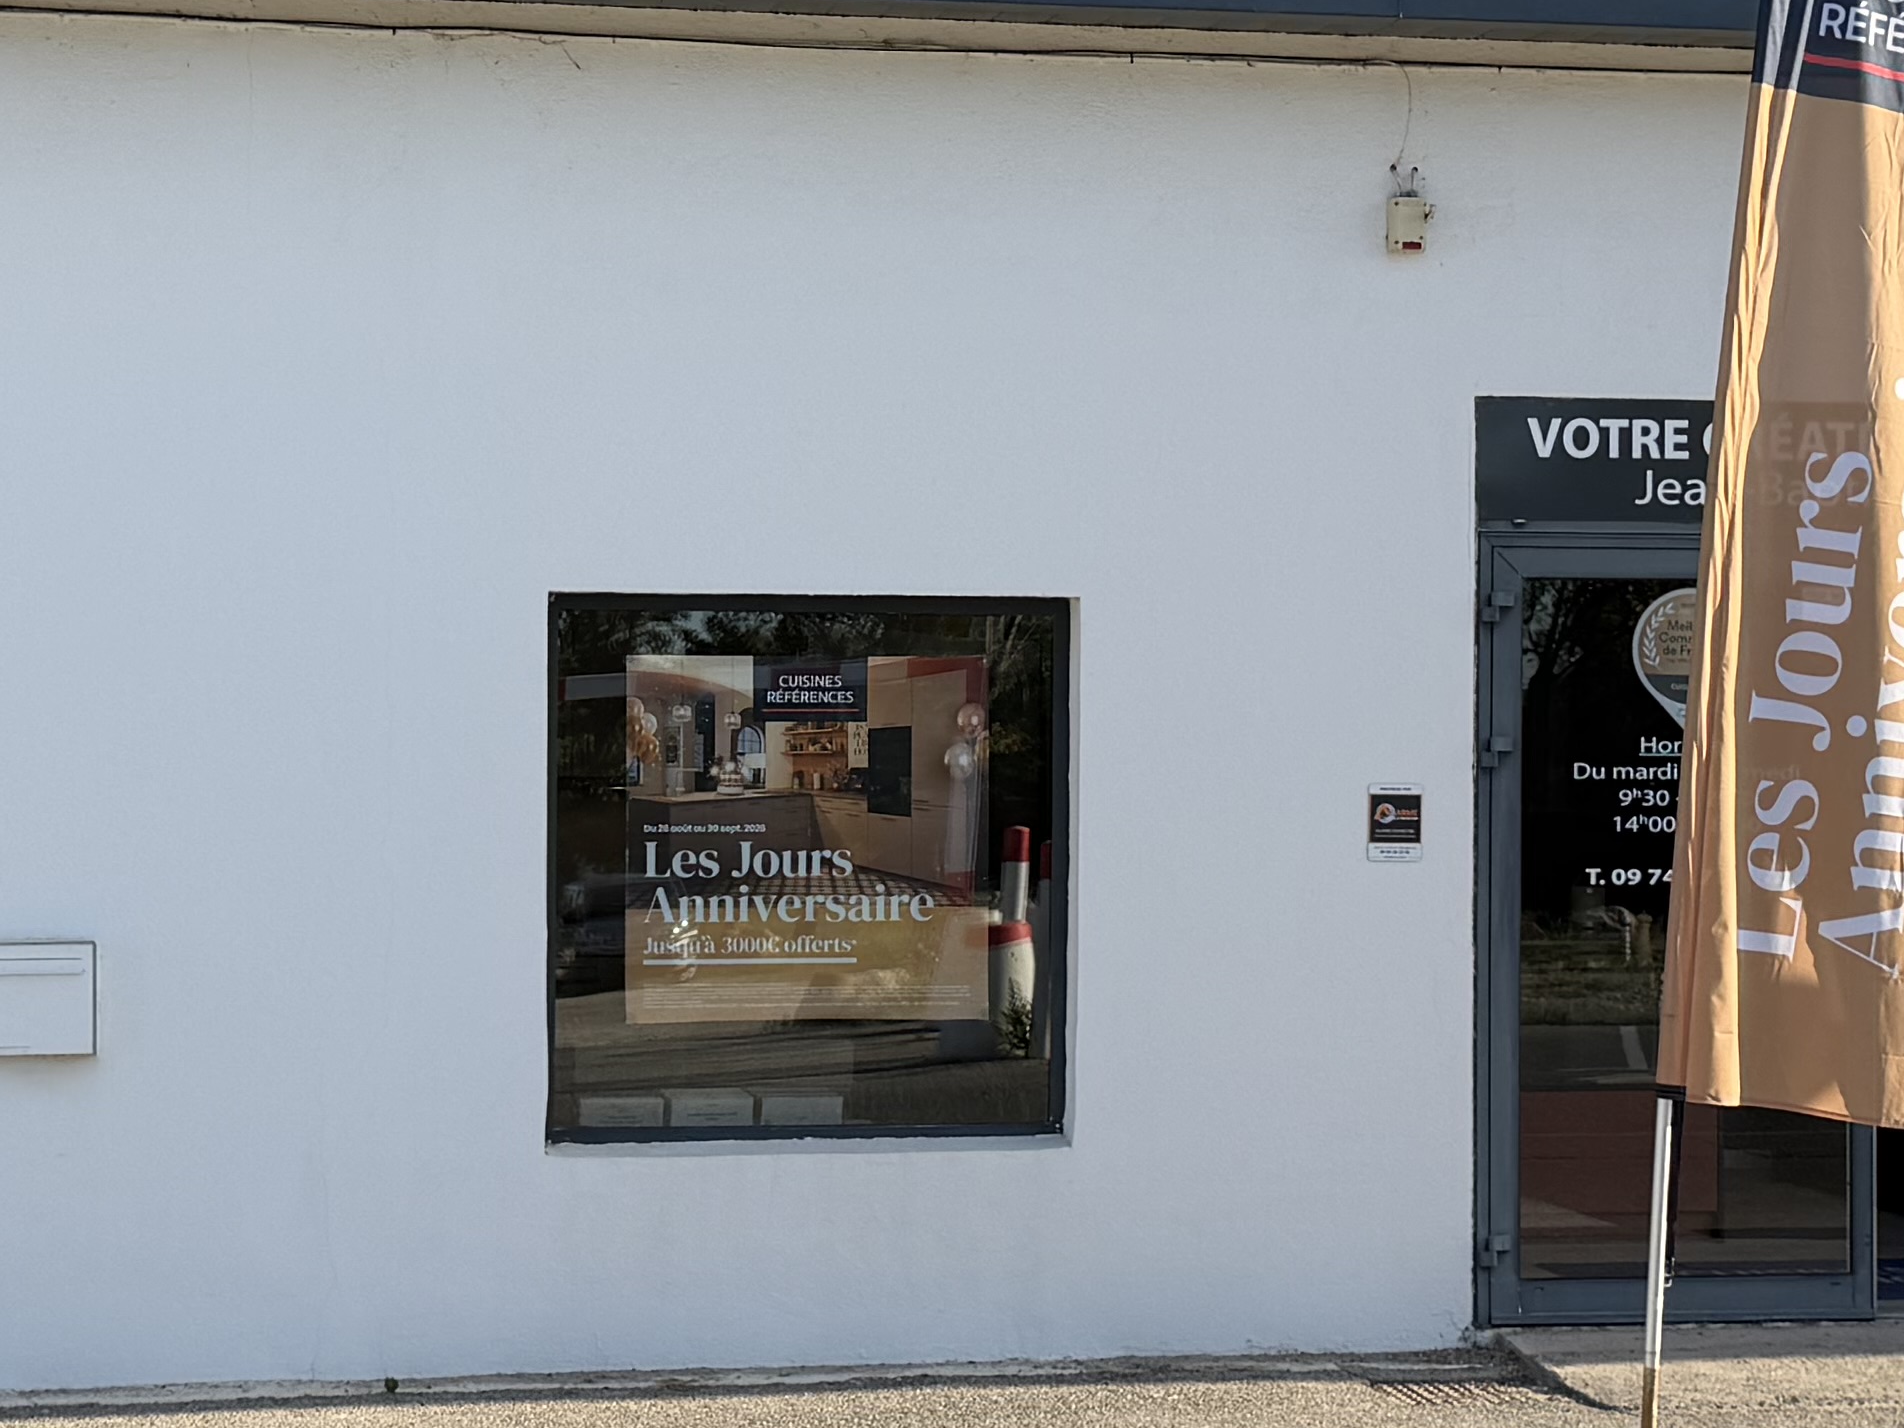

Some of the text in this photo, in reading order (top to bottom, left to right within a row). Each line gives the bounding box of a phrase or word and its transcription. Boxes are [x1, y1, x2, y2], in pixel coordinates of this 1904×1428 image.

[1526, 416, 1690, 460] VOTRE
[1634, 469, 1705, 506] Jea
[1747, 450, 1873, 753] Jours
[778, 675, 843, 688] CUISINES
[766, 688, 855, 704] RÉFÉRENCES
[1572, 762, 1679, 780] Du mardi
[1618, 789, 1671, 807] 9h30
[643, 840, 855, 880] Les Jours
[1736, 778, 1821, 963] Les
[1584, 867, 1607, 886] T.
[1610, 868, 1643, 886] 09
[643, 883, 936, 924] Anniversaire
[720, 935, 781, 954] 3000€
